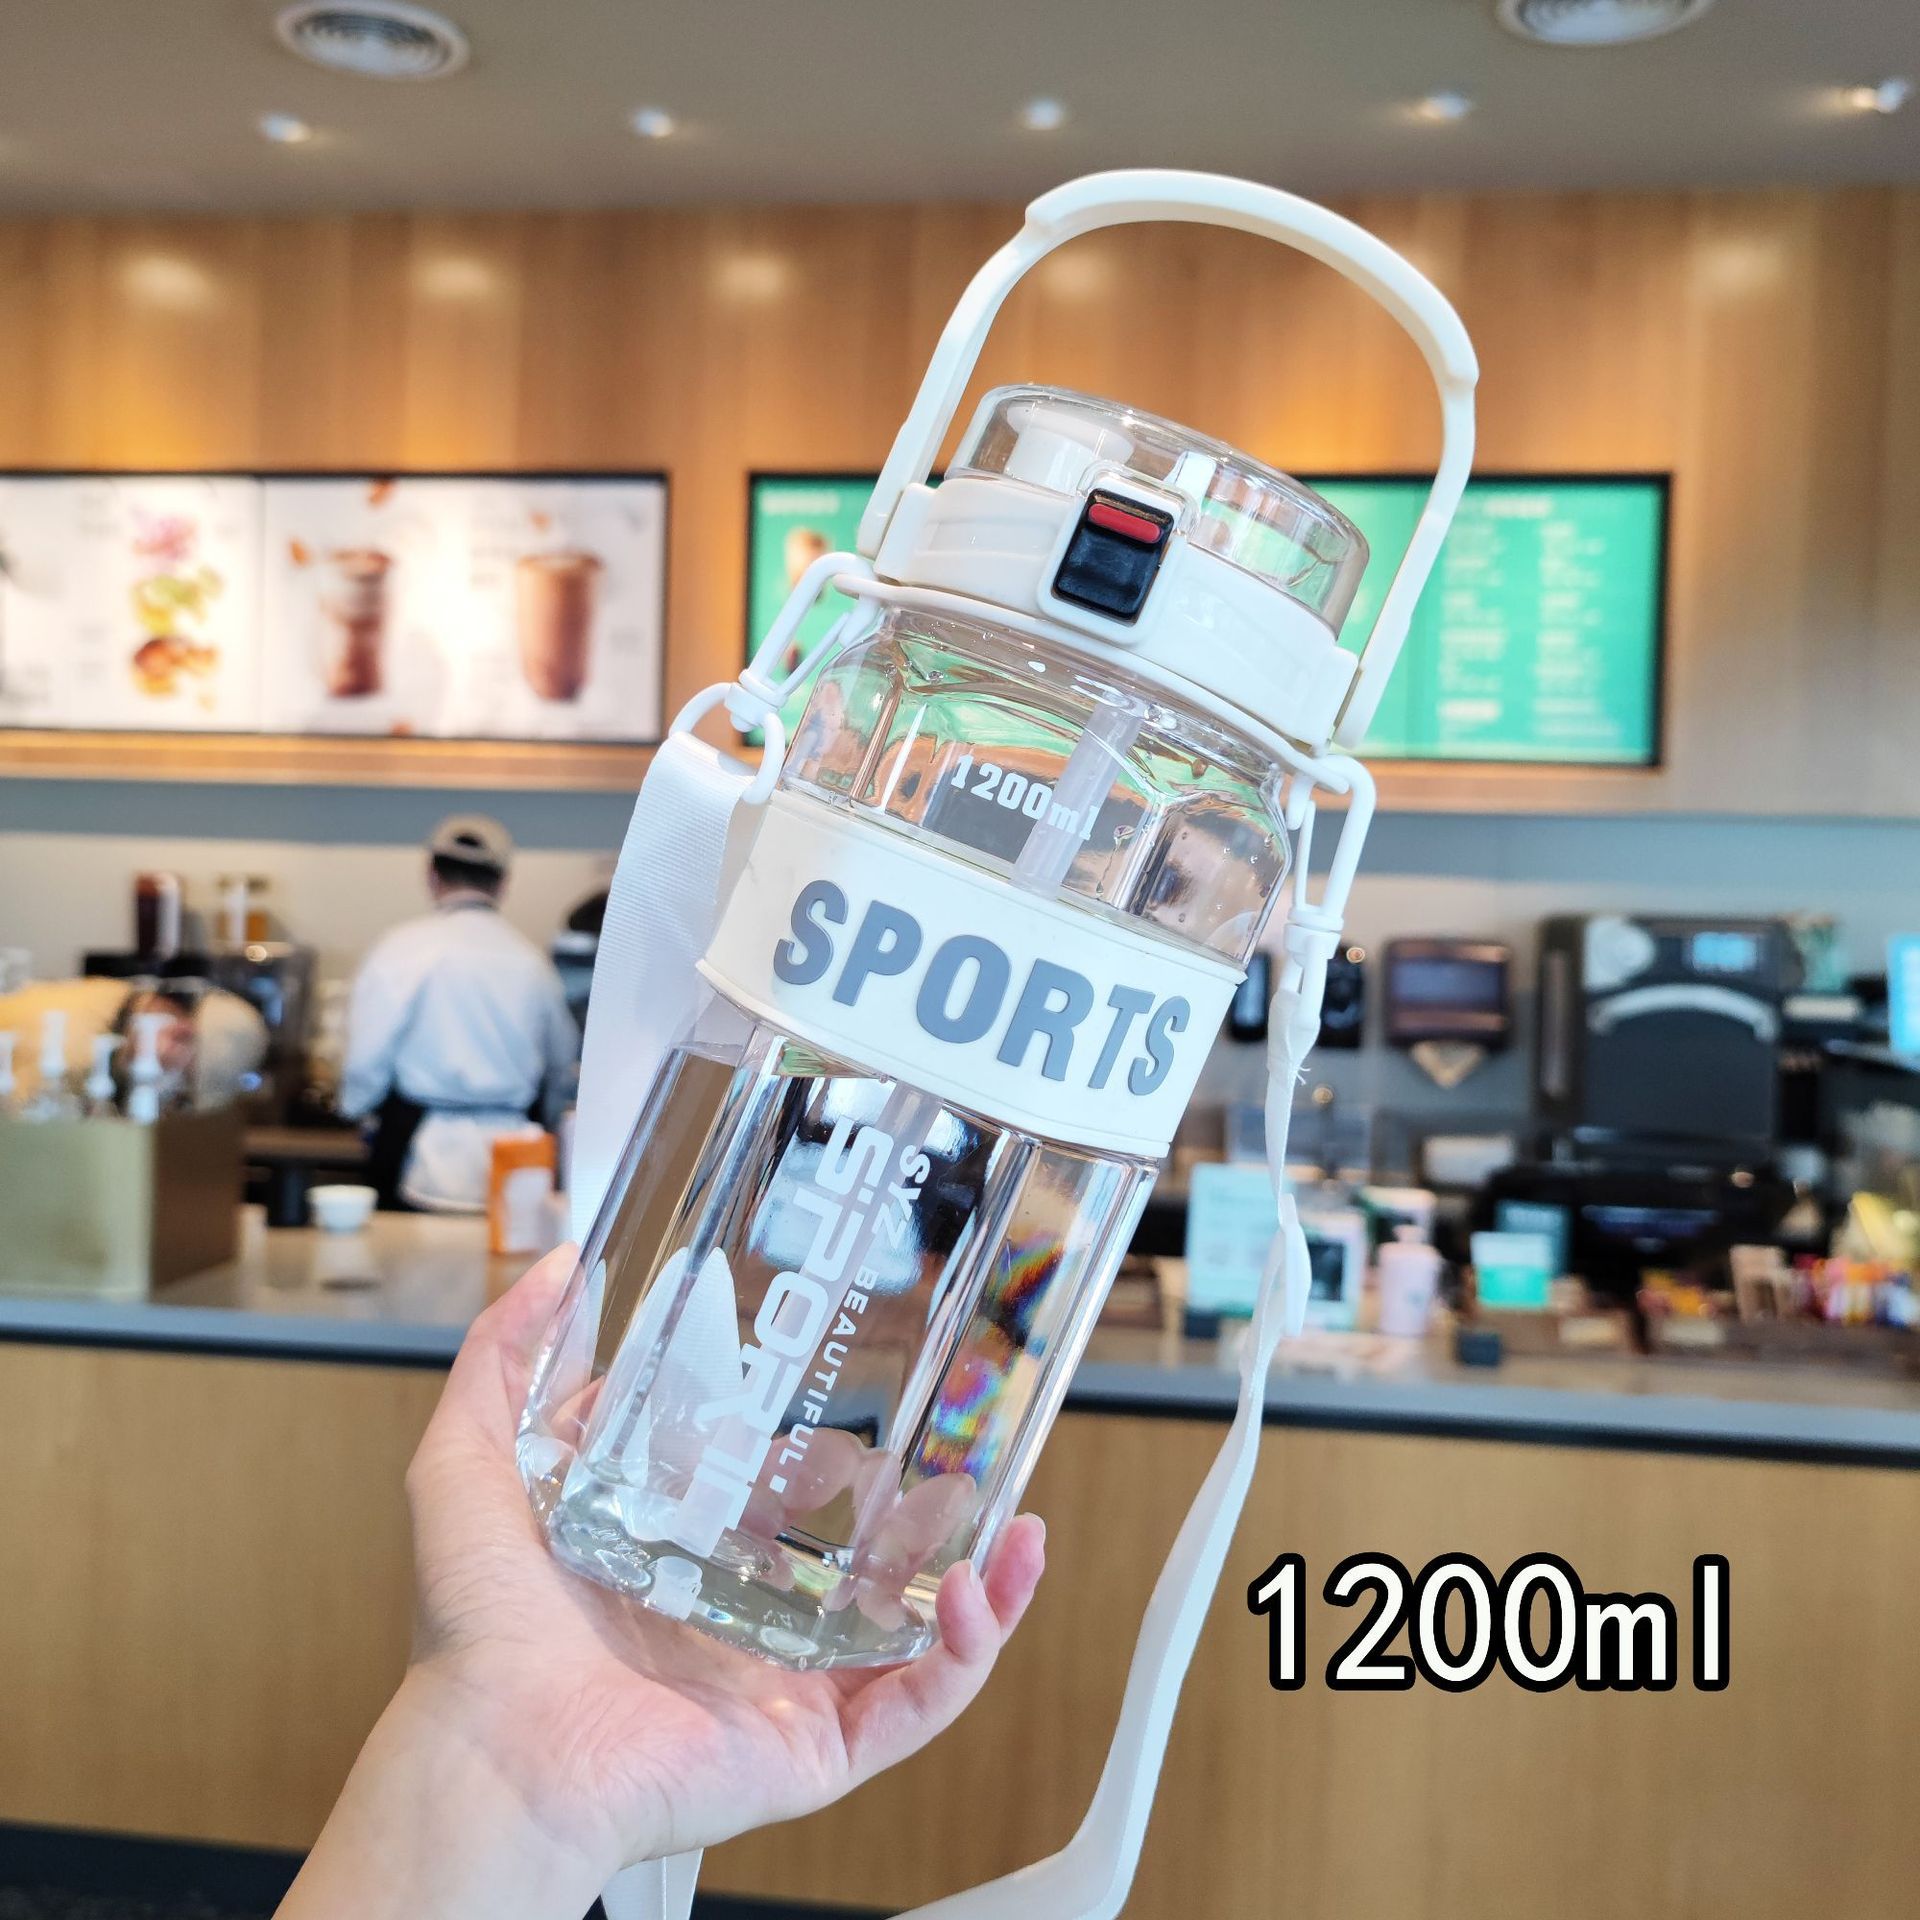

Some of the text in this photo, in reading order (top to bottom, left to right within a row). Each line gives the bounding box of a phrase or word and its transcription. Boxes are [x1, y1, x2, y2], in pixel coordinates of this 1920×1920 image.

[950, 753, 1100, 841] 1200ml
[773, 879, 1191, 1096] SPORTS
[870, 1144, 931, 1251] SYZ
